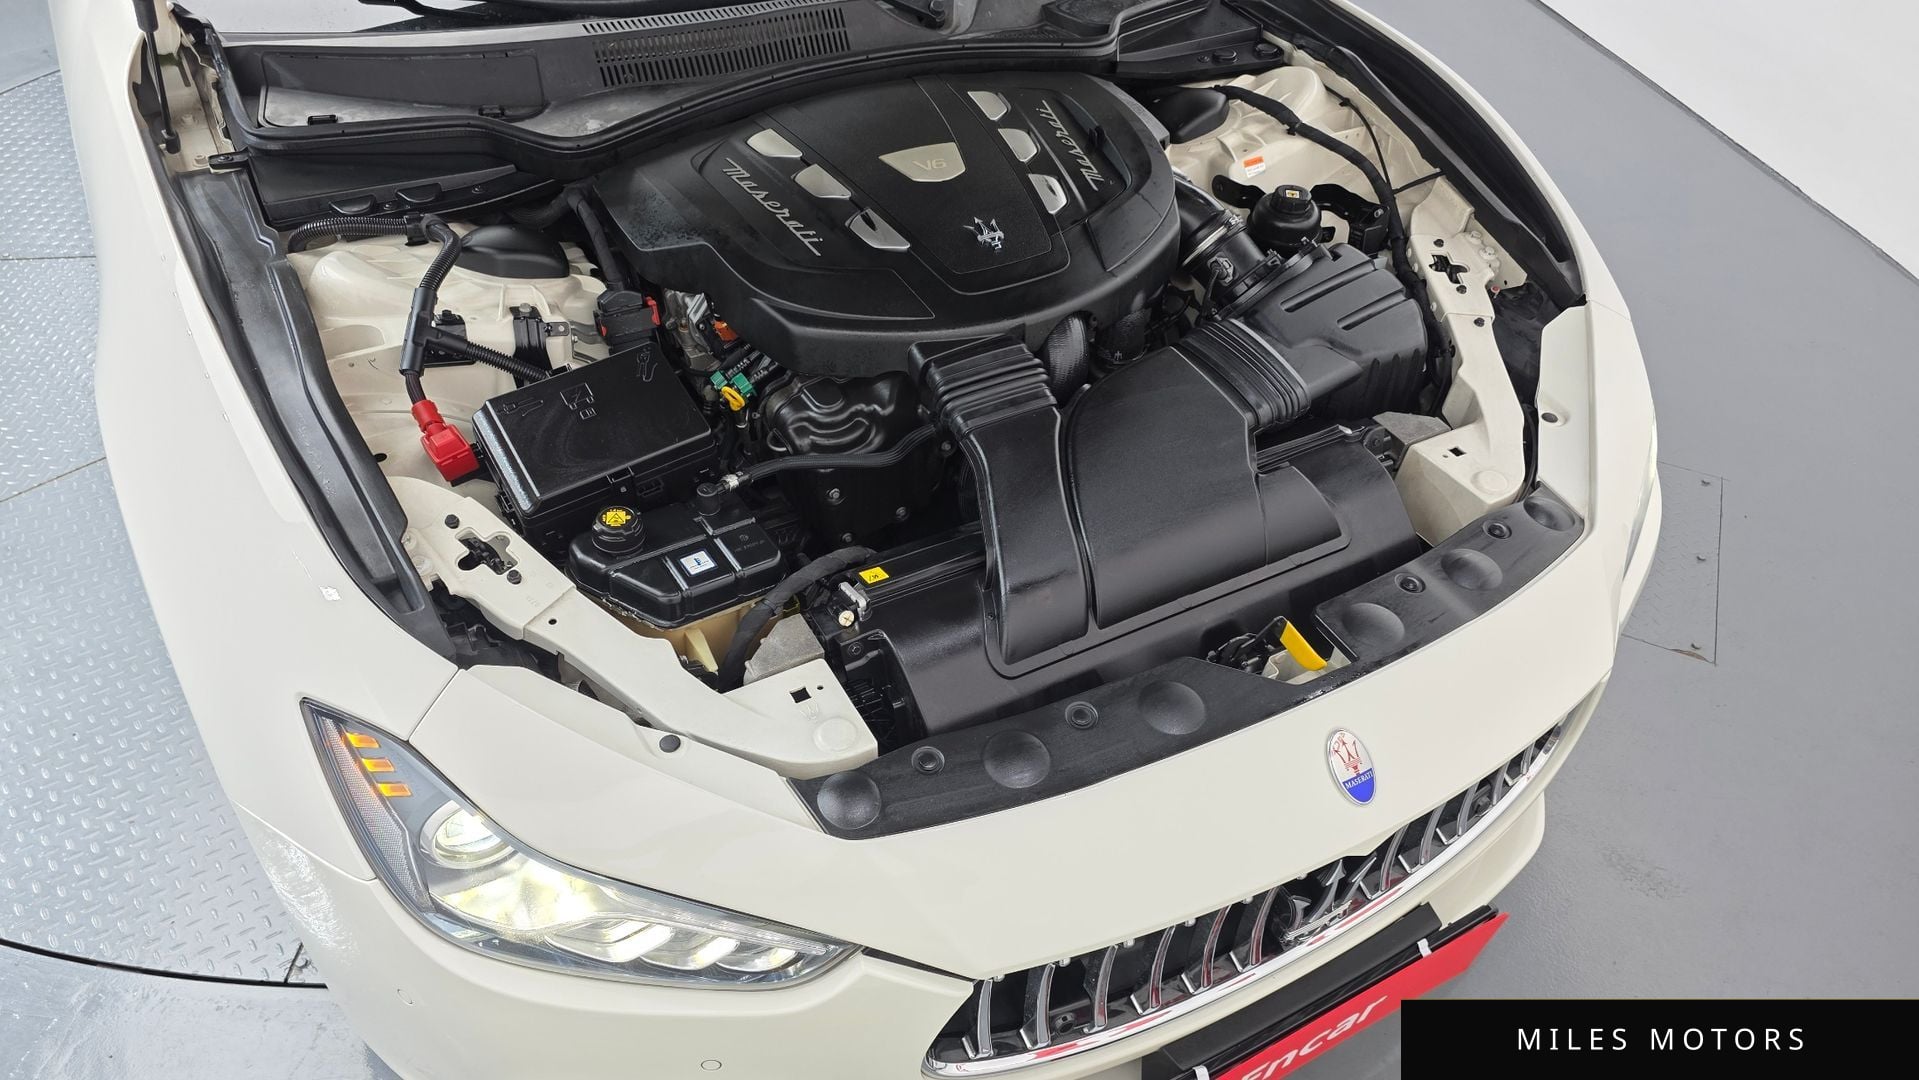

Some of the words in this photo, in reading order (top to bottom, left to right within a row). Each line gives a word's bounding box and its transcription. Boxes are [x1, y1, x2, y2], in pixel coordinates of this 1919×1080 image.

[912, 158, 947, 171] V6
[1036, 99, 1105, 191] Maserati
[722, 157, 823, 256] Maserati
[1344, 770, 1374, 789] MASERATI
